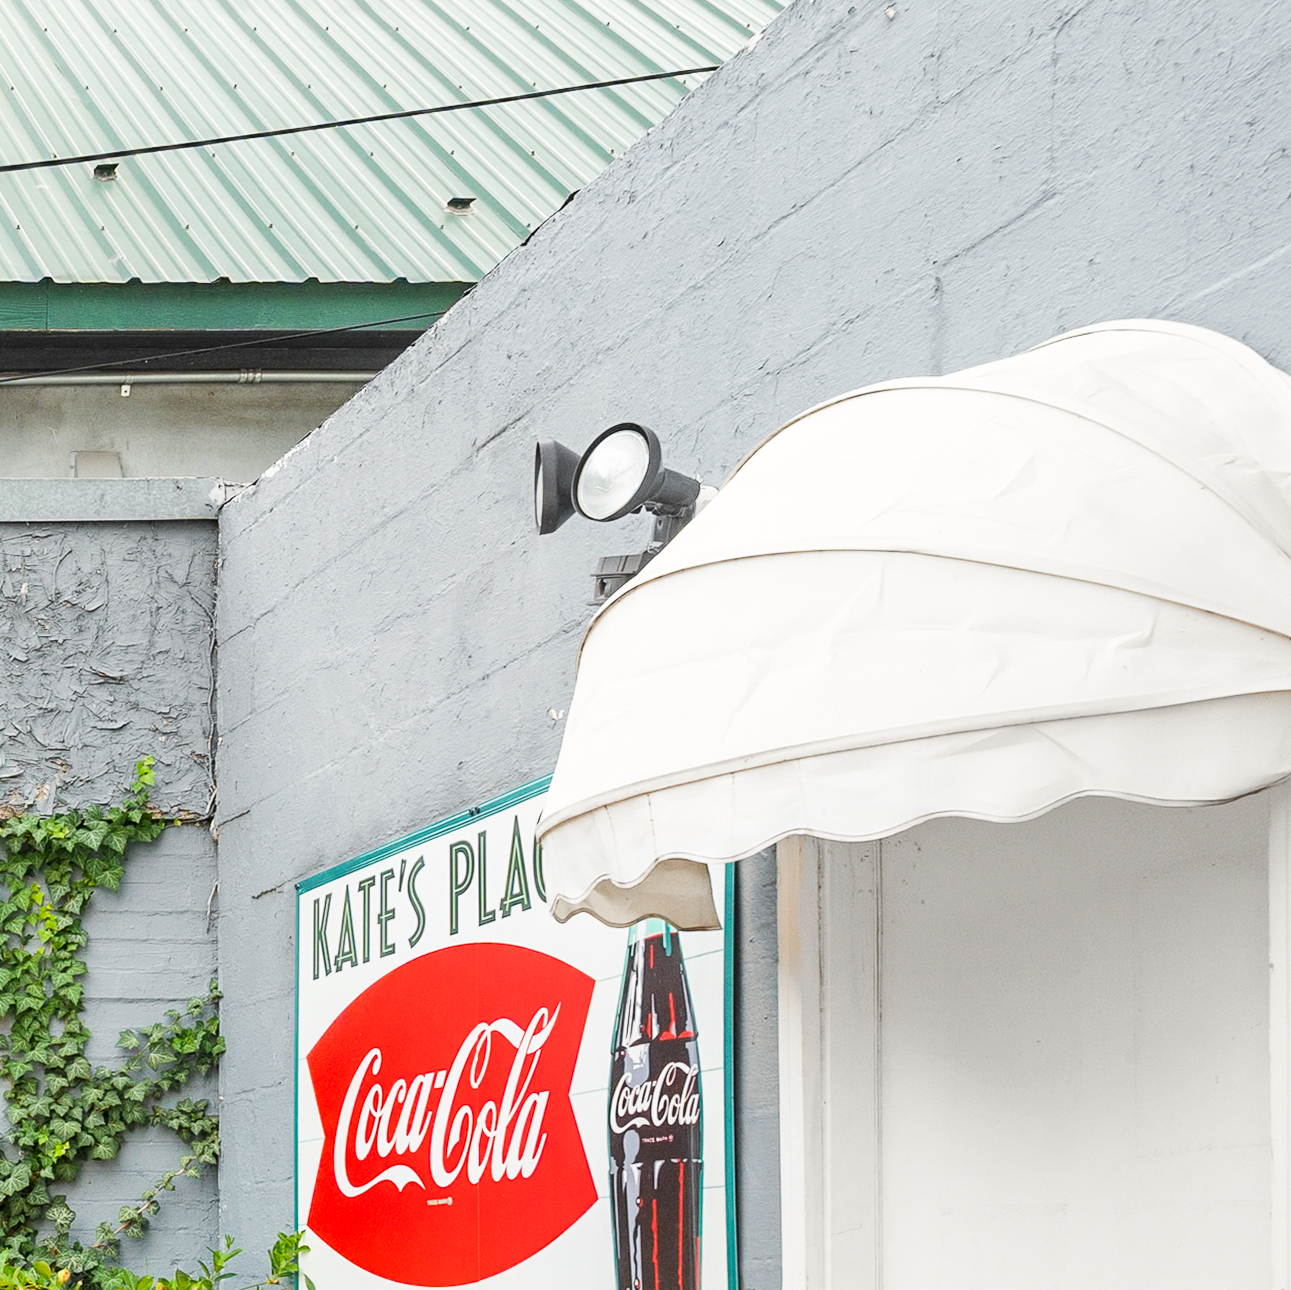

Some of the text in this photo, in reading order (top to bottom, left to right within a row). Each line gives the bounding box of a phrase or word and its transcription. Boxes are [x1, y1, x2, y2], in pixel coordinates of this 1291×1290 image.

[312, 854, 426, 981] KATE'S
[333, 1001, 562, 1198] Coca-Cola
[609, 1061, 700, 1134] Coca-Cola
